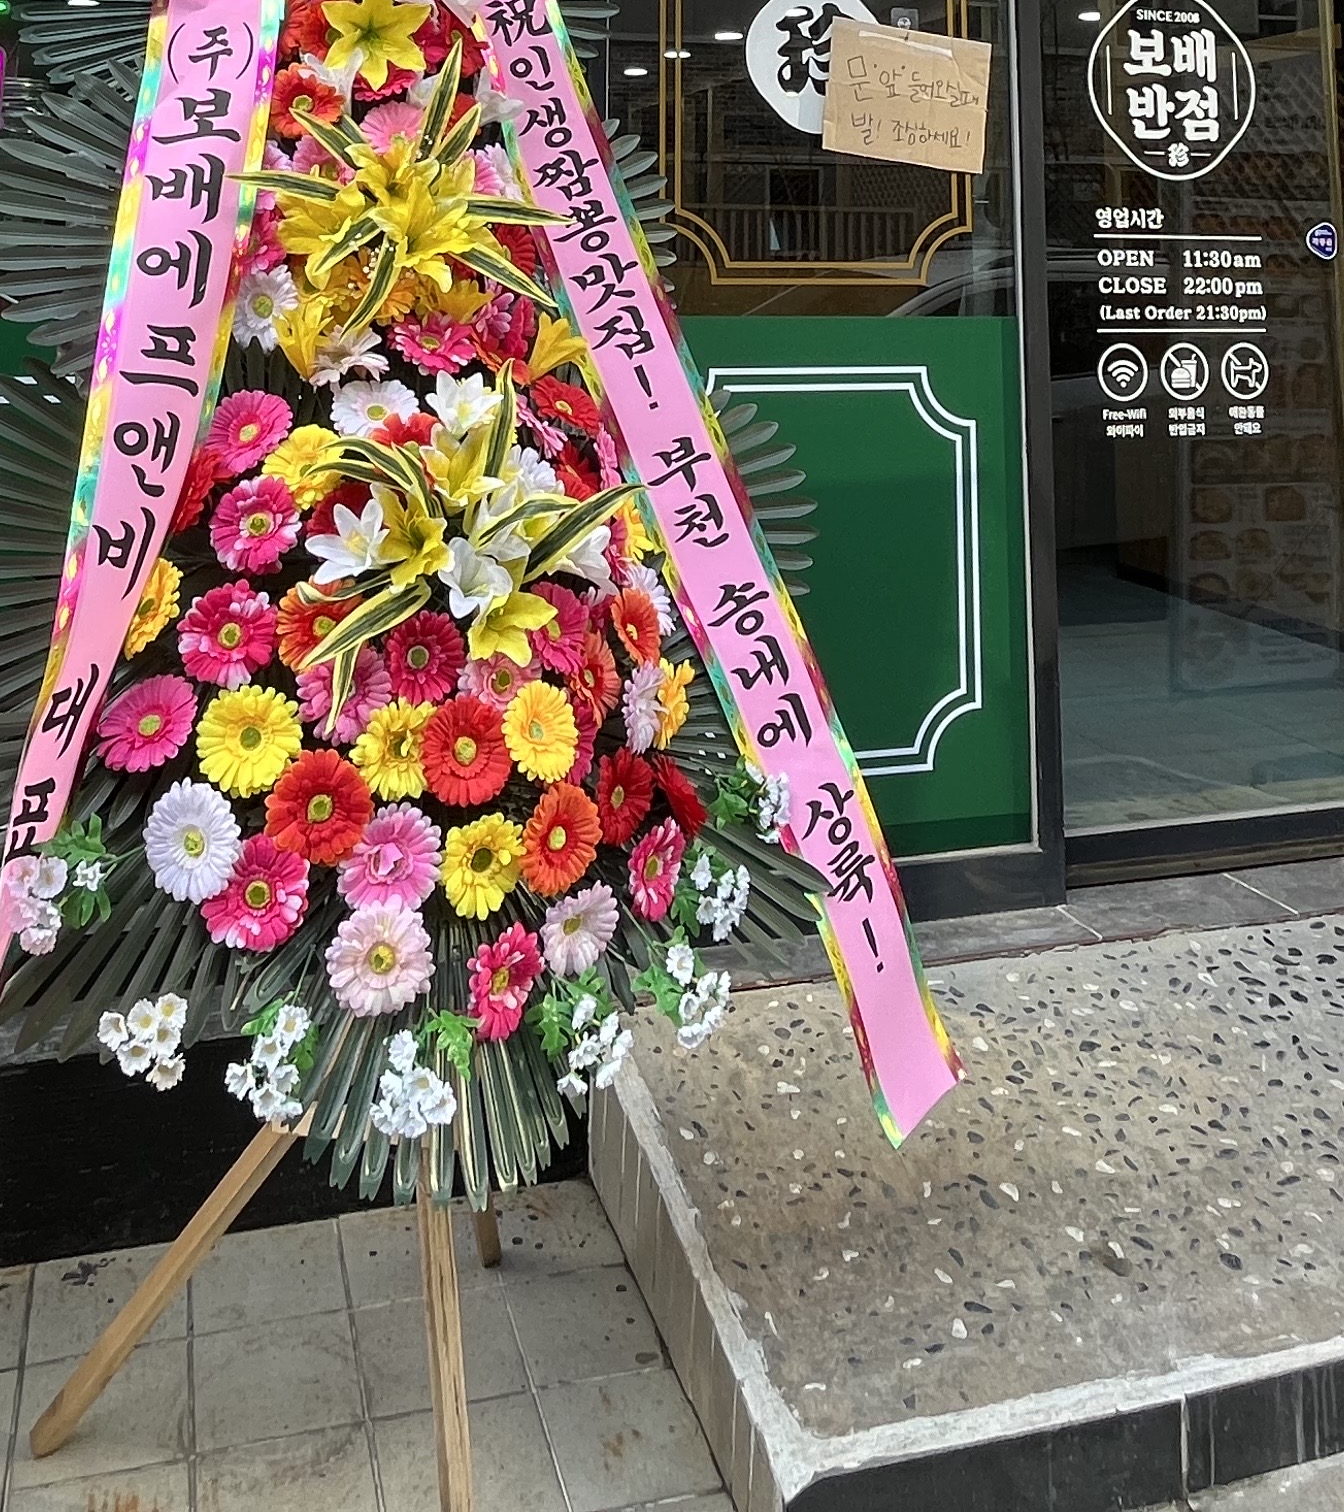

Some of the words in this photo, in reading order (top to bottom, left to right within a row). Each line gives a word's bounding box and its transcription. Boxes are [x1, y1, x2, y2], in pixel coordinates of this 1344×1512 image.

[1136, 8, 1172, 22] SINCE
[1123, 28, 1217, 83] 보배
[1126, 83, 1220, 142] 반점
[1095, 207, 1164, 229] 영업시간
[1097, 249, 1155, 267] OPEN
[1098, 277, 1167, 294] CLOSE
[1099, 305, 1141, 321] (Last
[1145, 305, 1192, 321] Order
[1195, 305, 1267, 322] 21:30pm)
[647, 436, 731, 547] 부천
[706, 581, 813, 750] 송내에
